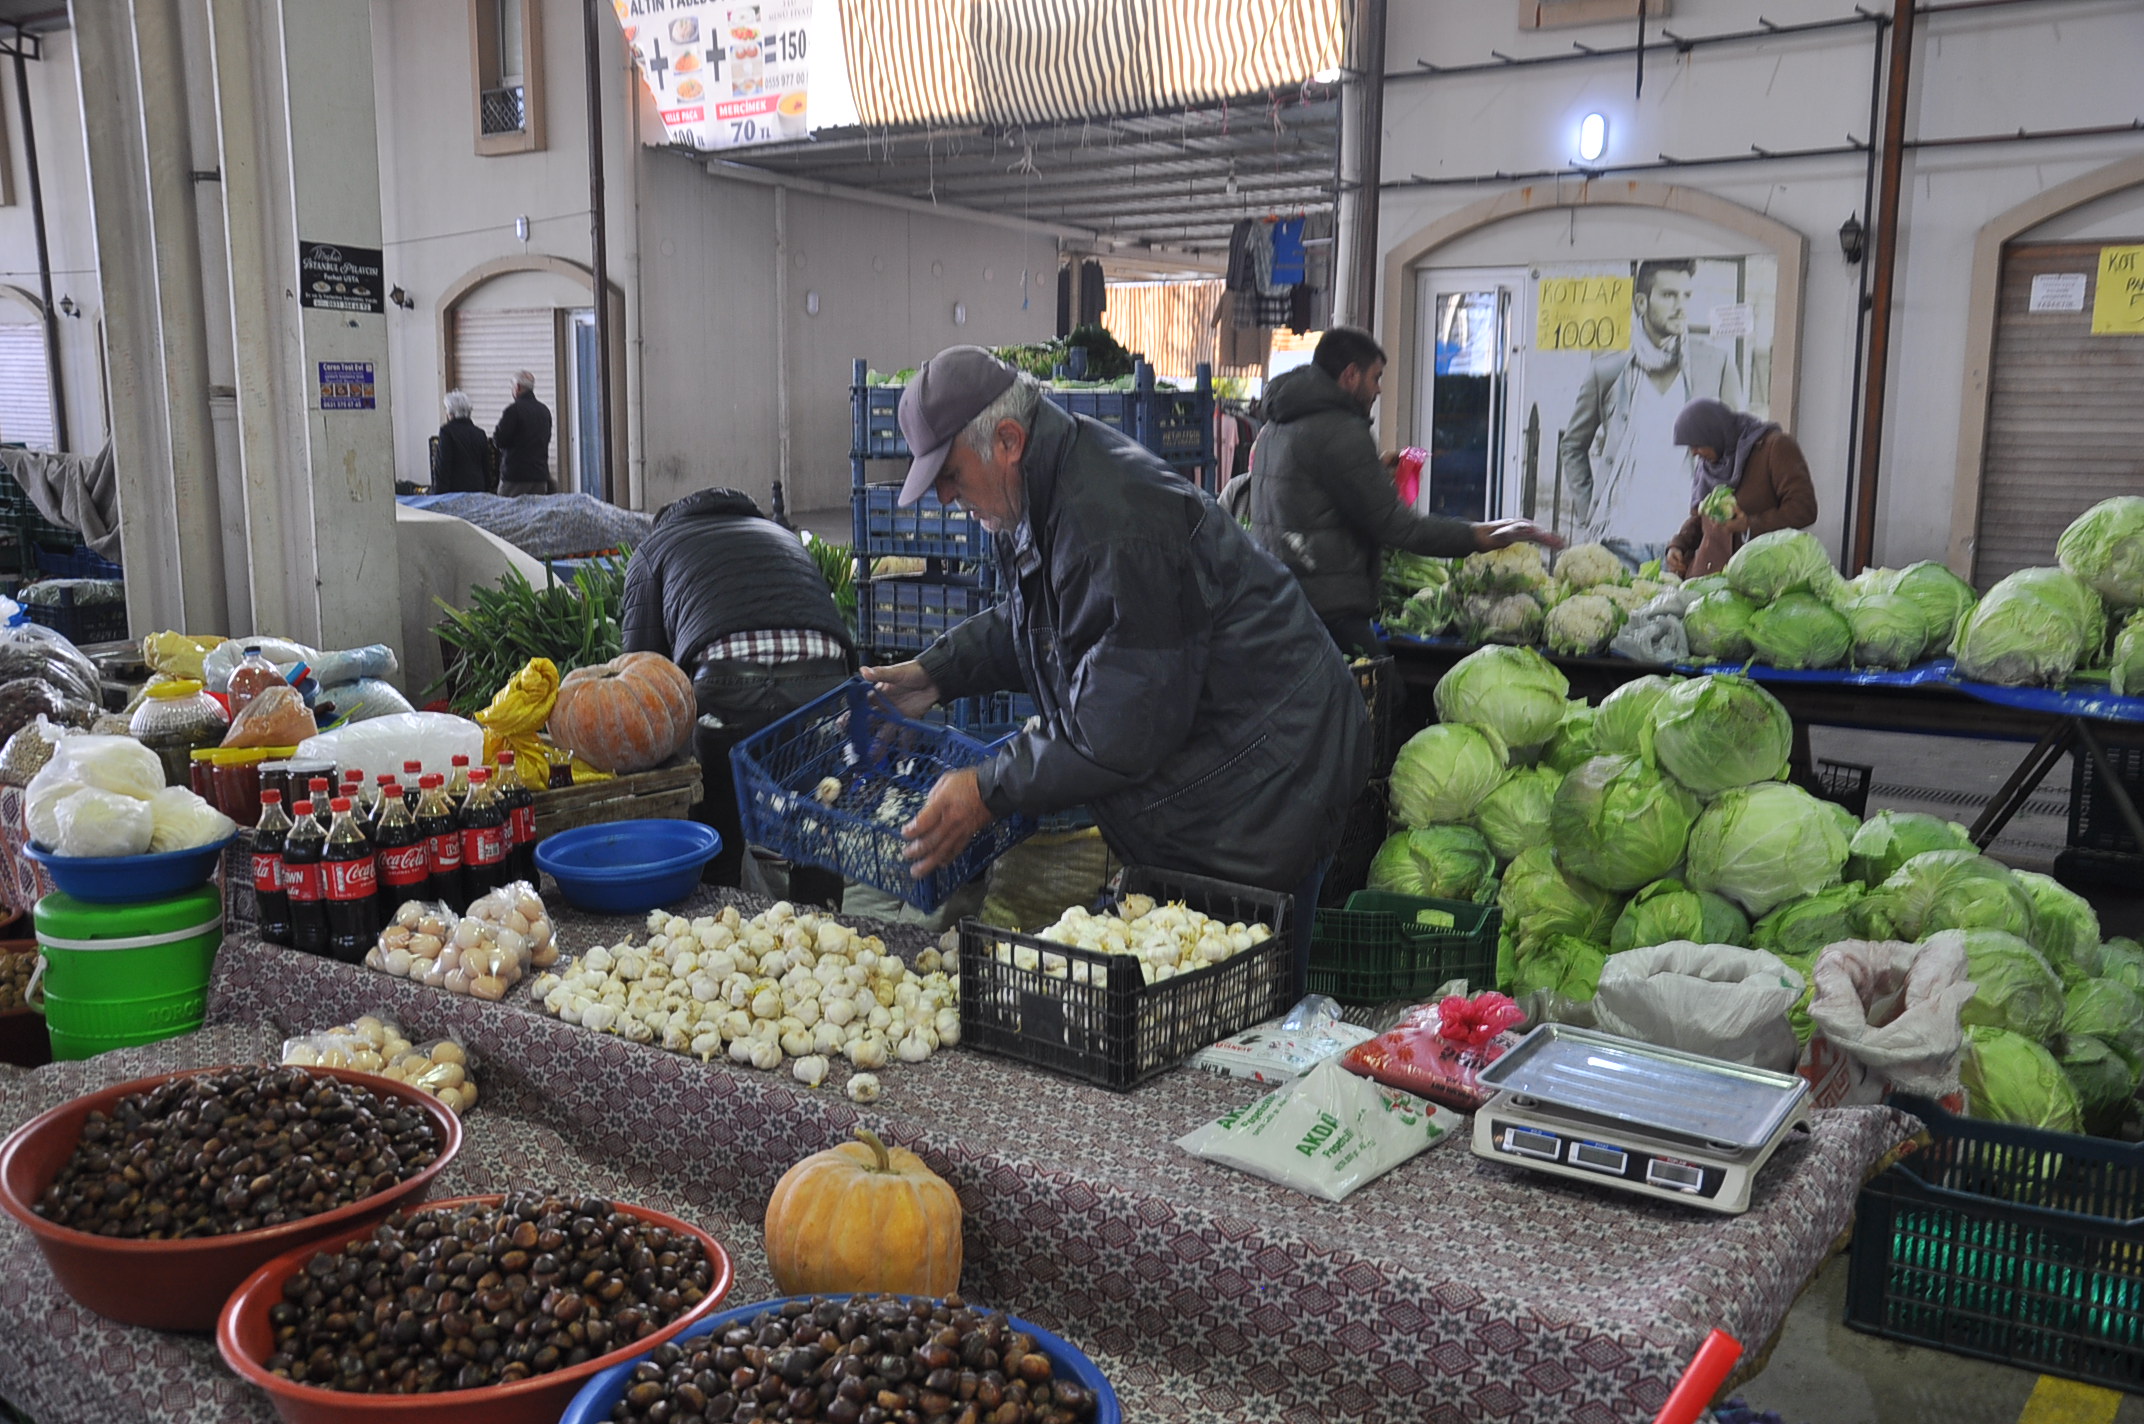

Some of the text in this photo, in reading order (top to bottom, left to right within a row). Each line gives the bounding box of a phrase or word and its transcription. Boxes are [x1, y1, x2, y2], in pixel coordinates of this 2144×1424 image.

[779, 28, 807, 61] 150
[719, 99, 767, 118] MERCİMEK
[730, 118, 756, 144] 70
[2107, 251, 2141, 273] KOT
[1554, 316, 1615, 350] 1000
